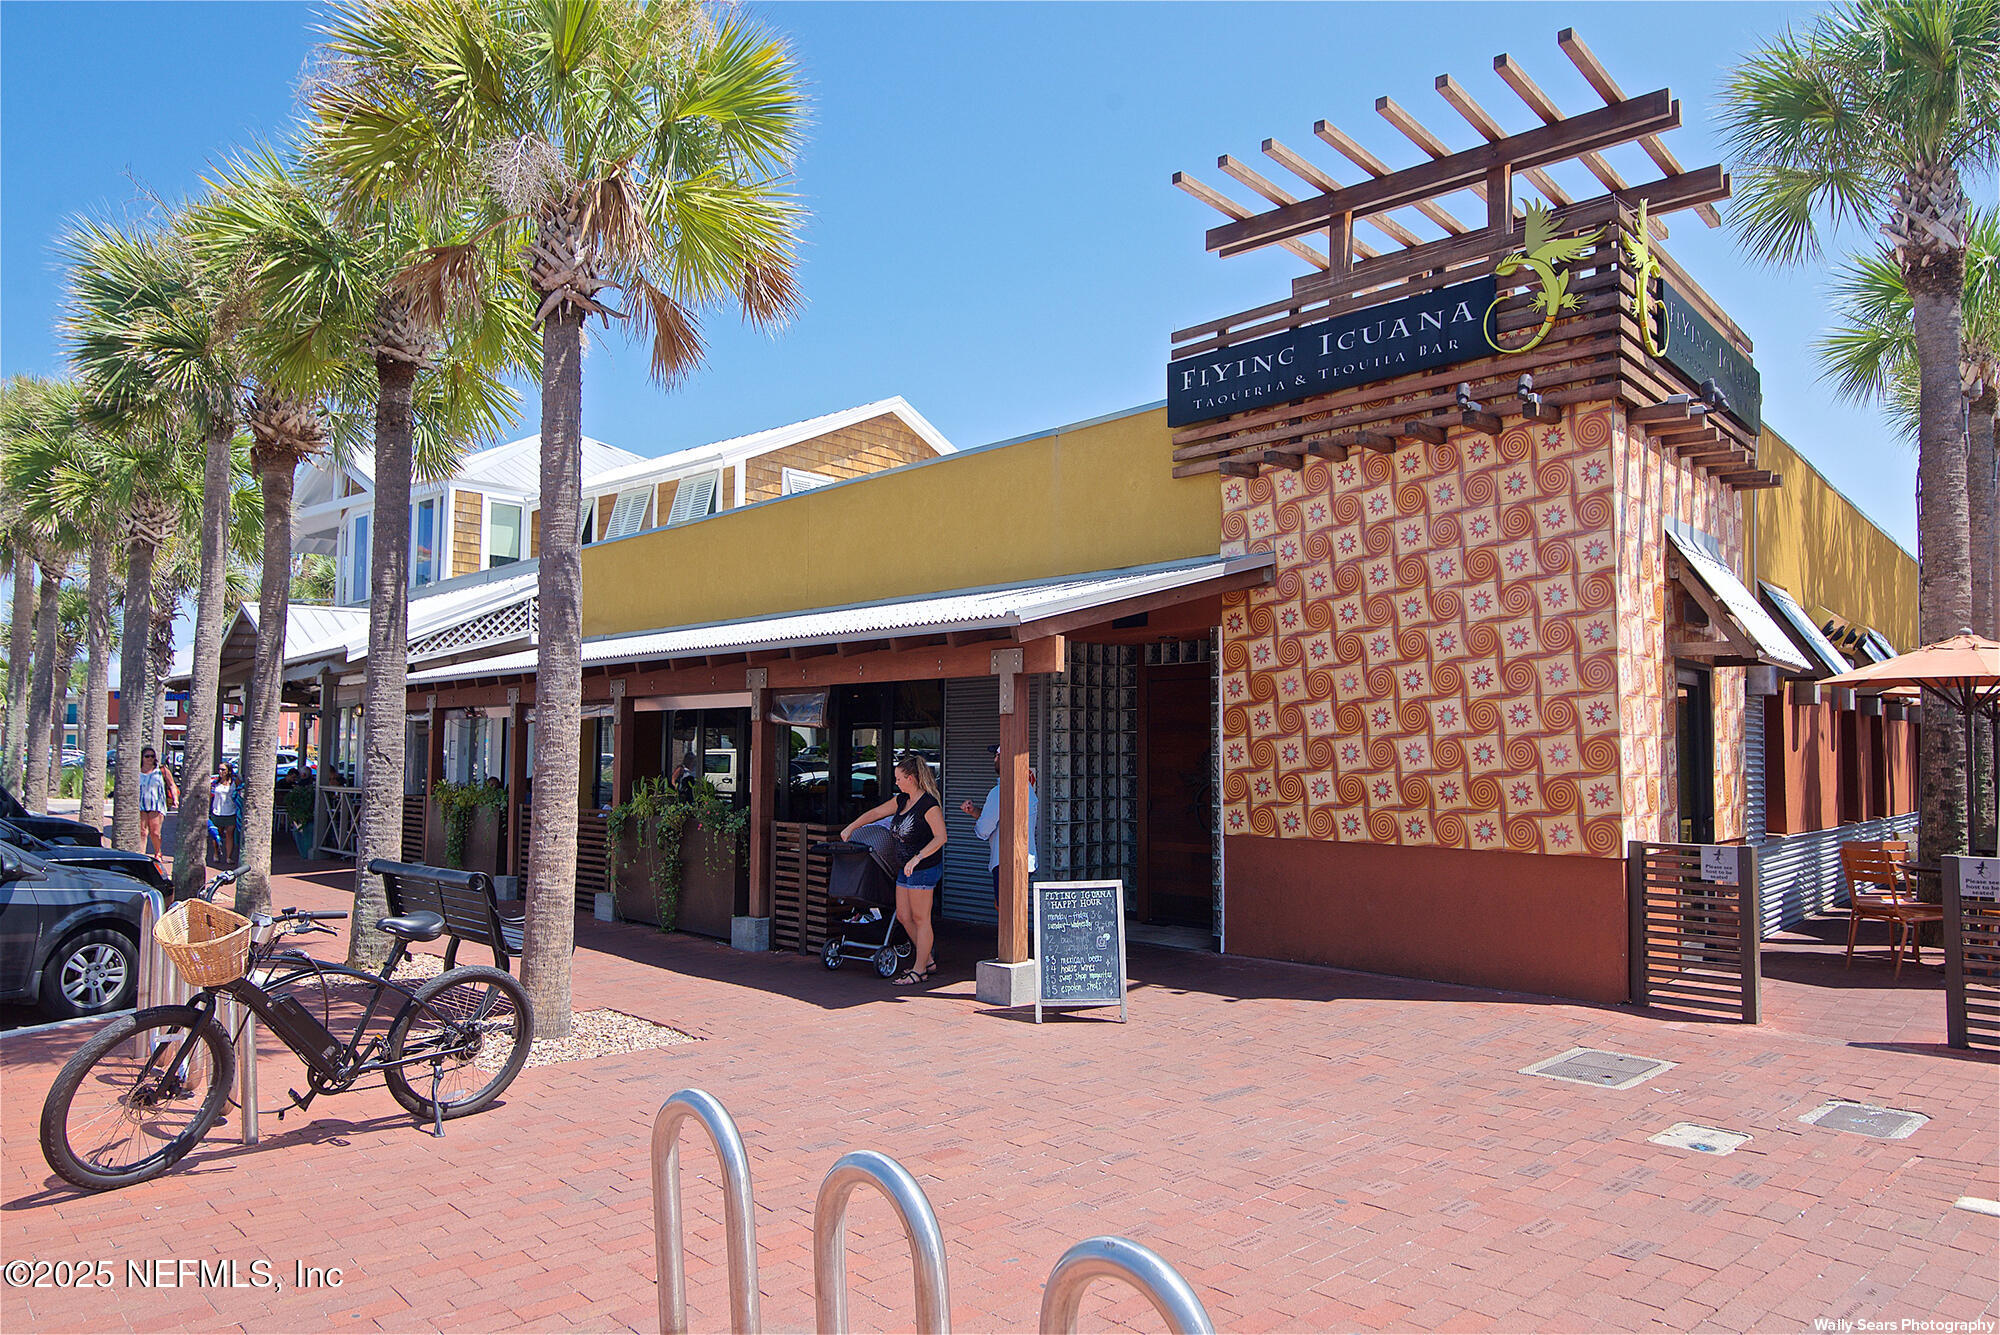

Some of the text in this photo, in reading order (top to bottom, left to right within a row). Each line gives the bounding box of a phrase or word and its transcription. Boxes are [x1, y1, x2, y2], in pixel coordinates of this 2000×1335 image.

[1180, 300, 1478, 391] FLYING IGUANA
[1193, 338, 1460, 410] TAQUERIA & TEQUILA BAR
[1045, 889, 1113, 900] FLYING IGUANA
[1050, 898, 1102, 909] HAPPY HOUR
[1060, 964, 1077, 973] house
